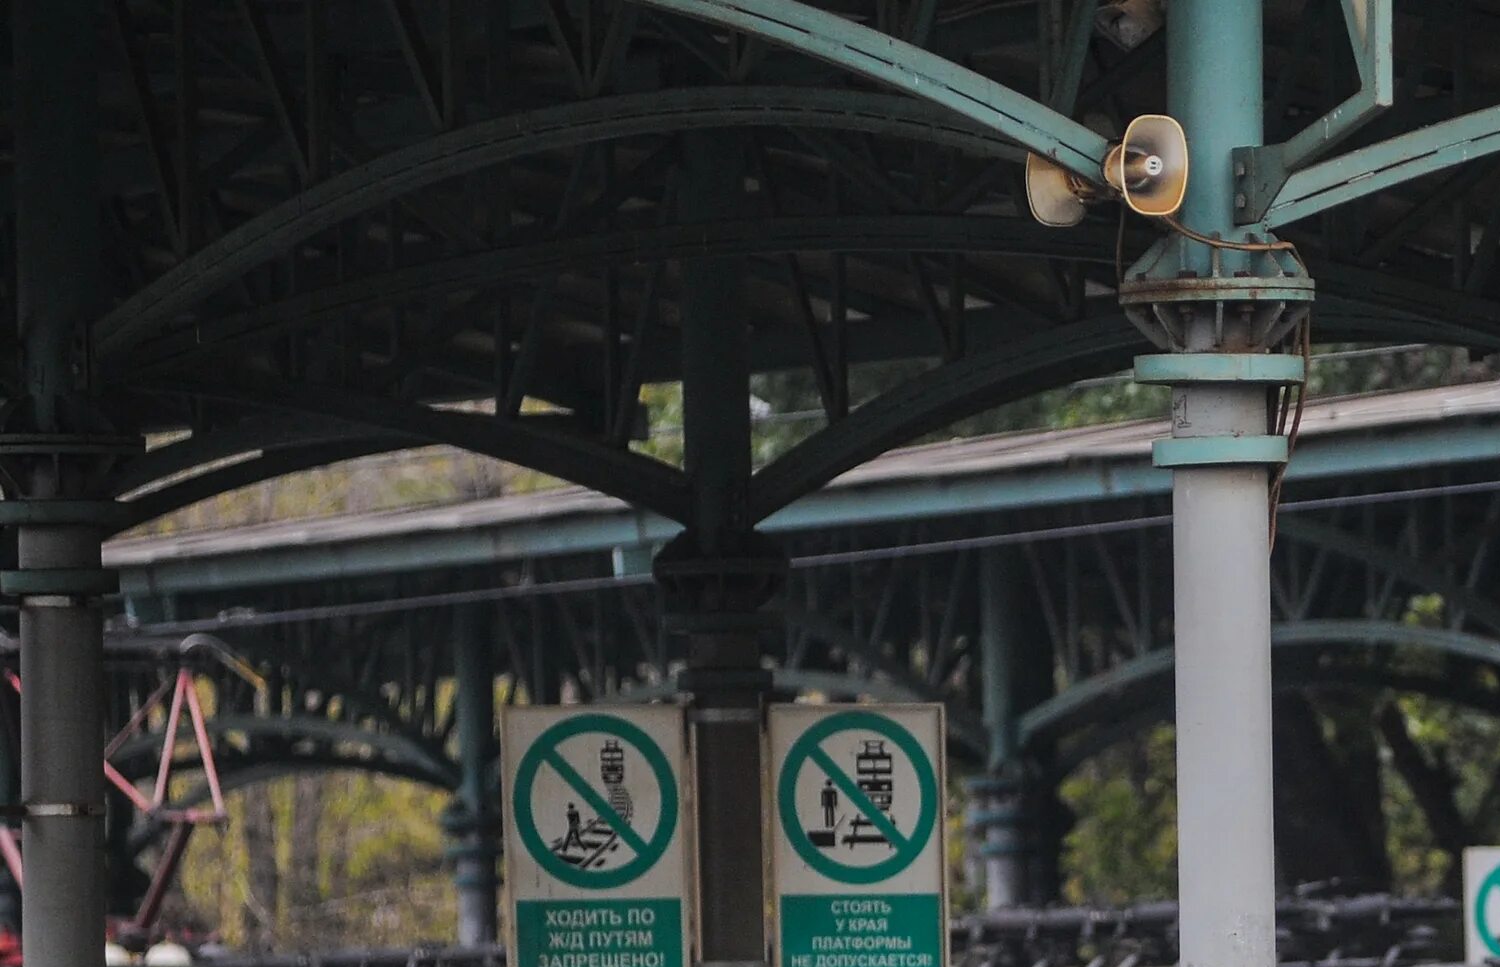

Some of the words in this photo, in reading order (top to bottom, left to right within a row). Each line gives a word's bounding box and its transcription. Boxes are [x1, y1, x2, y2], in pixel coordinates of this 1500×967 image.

[831, 900, 892, 914] СТОЯТЬ
[546, 909, 622, 928] ХОДИТЬ
[627, 907, 656, 924] ПО
[835, 918, 845, 933] У
[848, 918, 888, 932] КРАЯ
[549, 931, 584, 950] Ж/Д
[589, 930, 653, 948] ПУТЯМ
[812, 935, 912, 950] ПЛАТФОРМЫ
